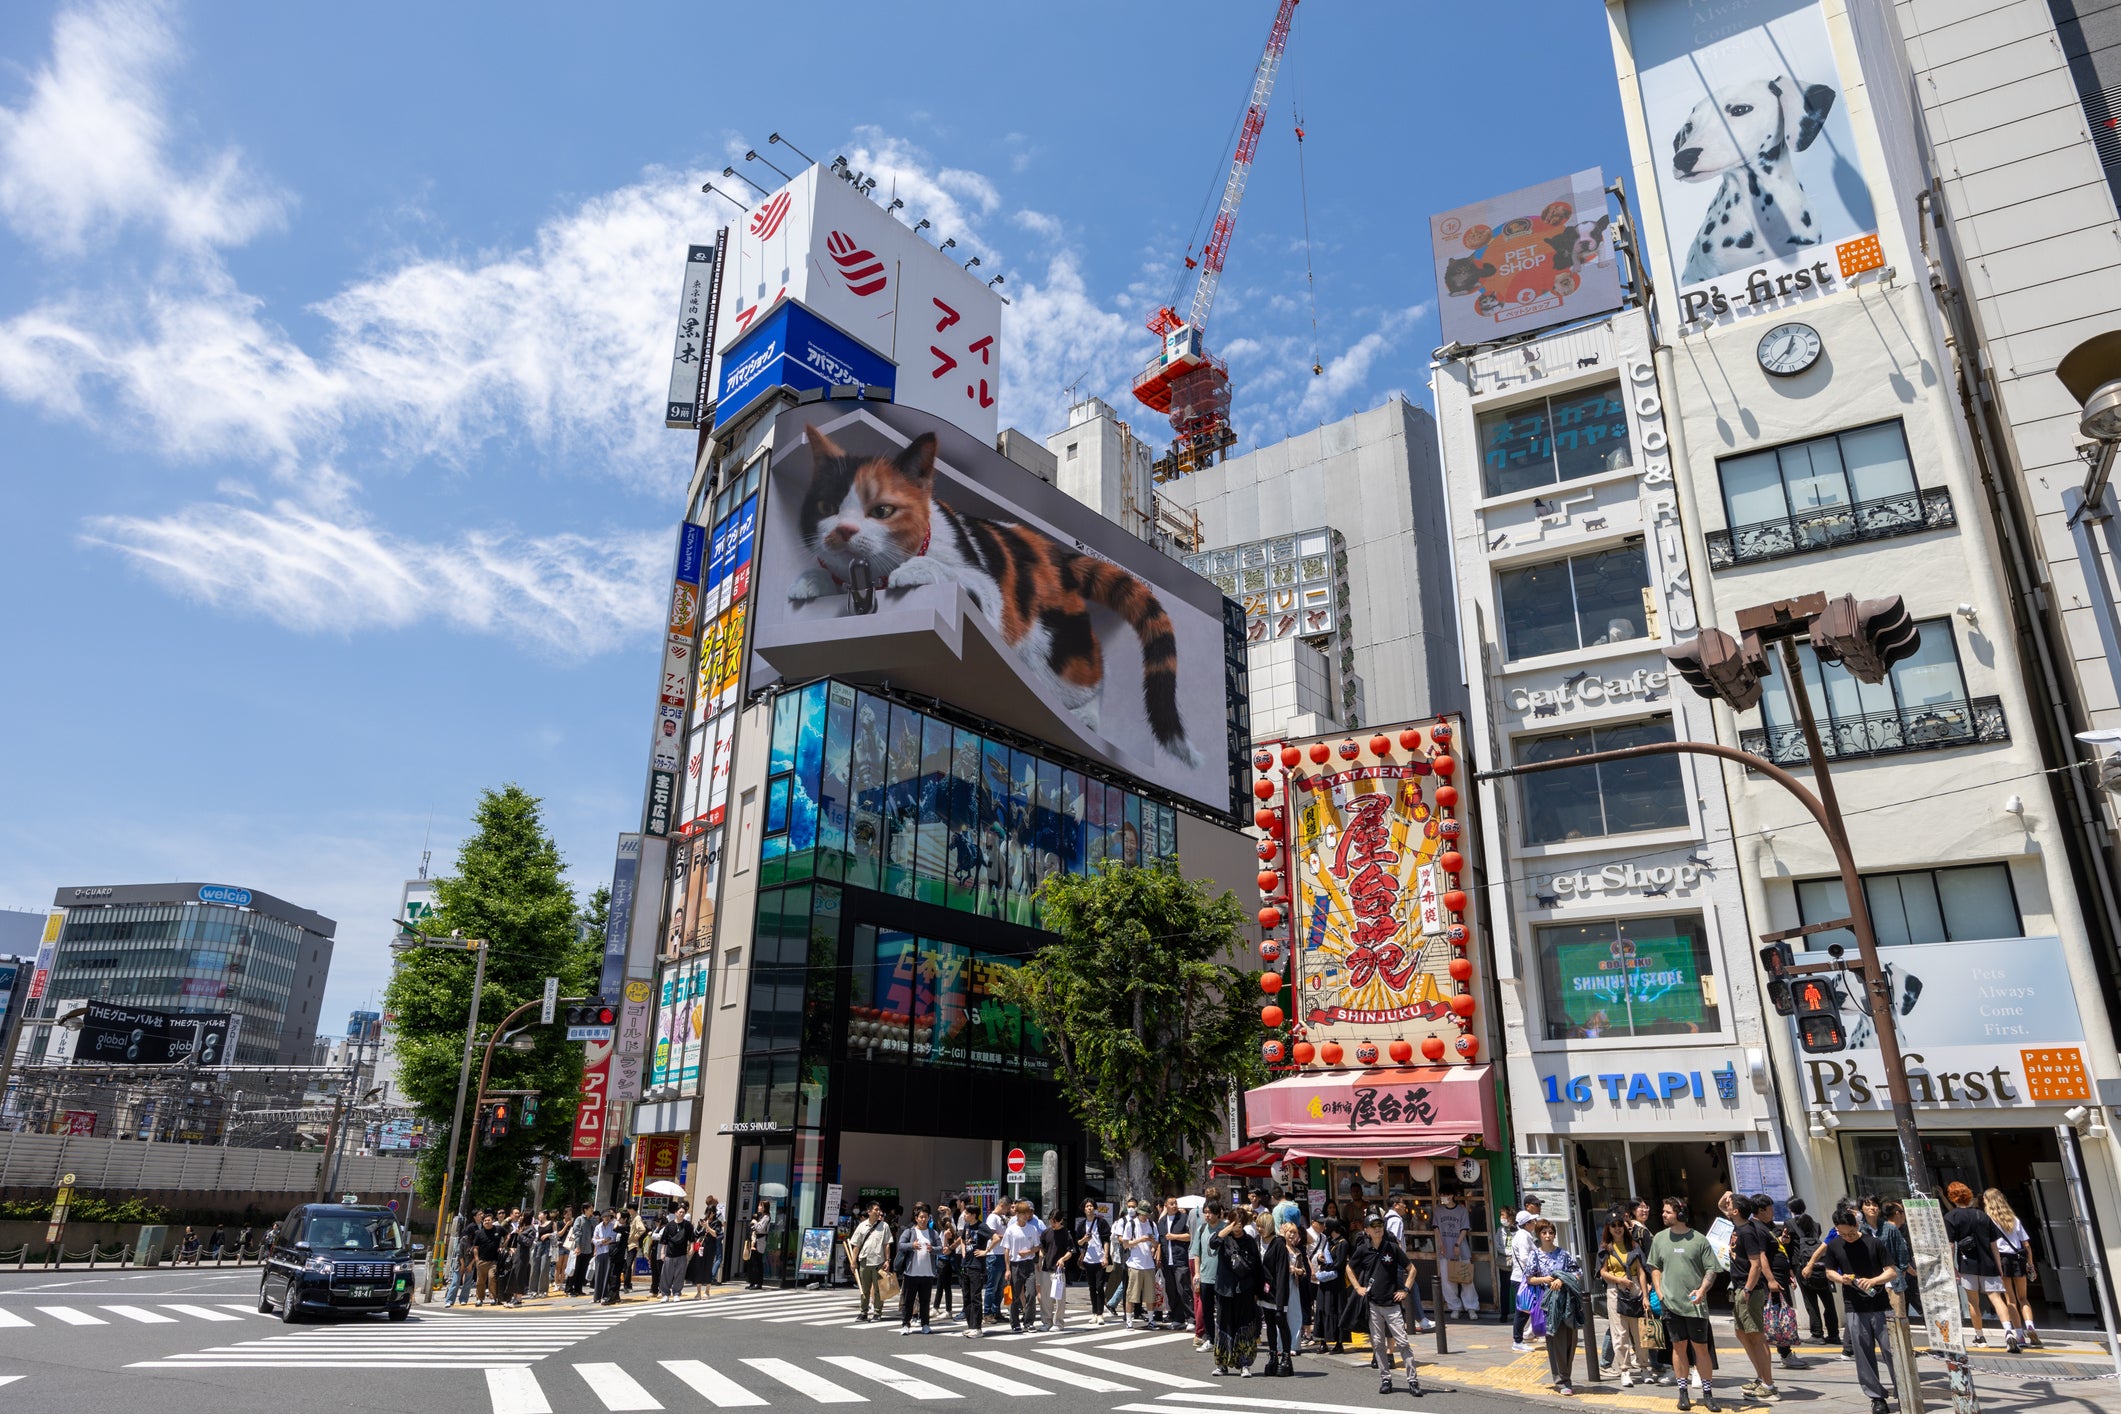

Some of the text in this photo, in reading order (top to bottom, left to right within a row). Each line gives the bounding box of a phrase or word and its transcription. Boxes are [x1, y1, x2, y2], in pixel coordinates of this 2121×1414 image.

[1505, 244, 1538, 263] PET
[1841, 244, 1878, 261] always
[1842, 251, 1879, 268] come
[1499, 255, 1547, 277] SHOP
[1843, 258, 1881, 275] first
[1506, 301, 1551, 317] ペットショップ
[675, 317, 700, 364] 黒木
[726, 341, 776, 393] アパマンショップ
[807, 347, 873, 393] アパマンショッ
[1506, 669, 1668, 711] Cat Cafe
[668, 696, 679, 705] 4F
[660, 705, 683, 719] 足つぼ
[1326, 767, 1403, 786] YATAIEN
[650, 774, 671, 835] 宝石広場
[693, 846, 721, 872] Foot
[1524, 864, 1702, 896] Pet Shop
[203, 888, 248, 903] welcia
[1328, 793, 1422, 991] 屋台苑
[1422, 890, 1439, 923] 布袋
[1640, 970, 1685, 987] STORE
[1972, 967, 2006, 981] Pets
[1977, 985, 2035, 1000] Always
[89, 1006, 163, 1028] THEグローバル社
[1337, 1005, 1422, 1022] SHINJUKU
[1980, 1004, 2024, 1018] Come
[170, 1019, 226, 1028] THEグローバル社
[571, 1029, 609, 1038] 自転車専用
[96, 1034, 128, 1051] global
[2028, 1063, 2081, 1075] always
[1542, 1071, 1704, 1103] 16 TAPI
[1718, 1079, 1734, 1090] 16
[2031, 1075, 2083, 1085] come
[2034, 1086, 2086, 1097] first
[580, 1073, 605, 1130] アコム
[1347, 1087, 1439, 1131] 屋台苑
[750, 1122, 777, 1131] SHINJUKU
[1461, 1158, 1473, 1179] 布袋
